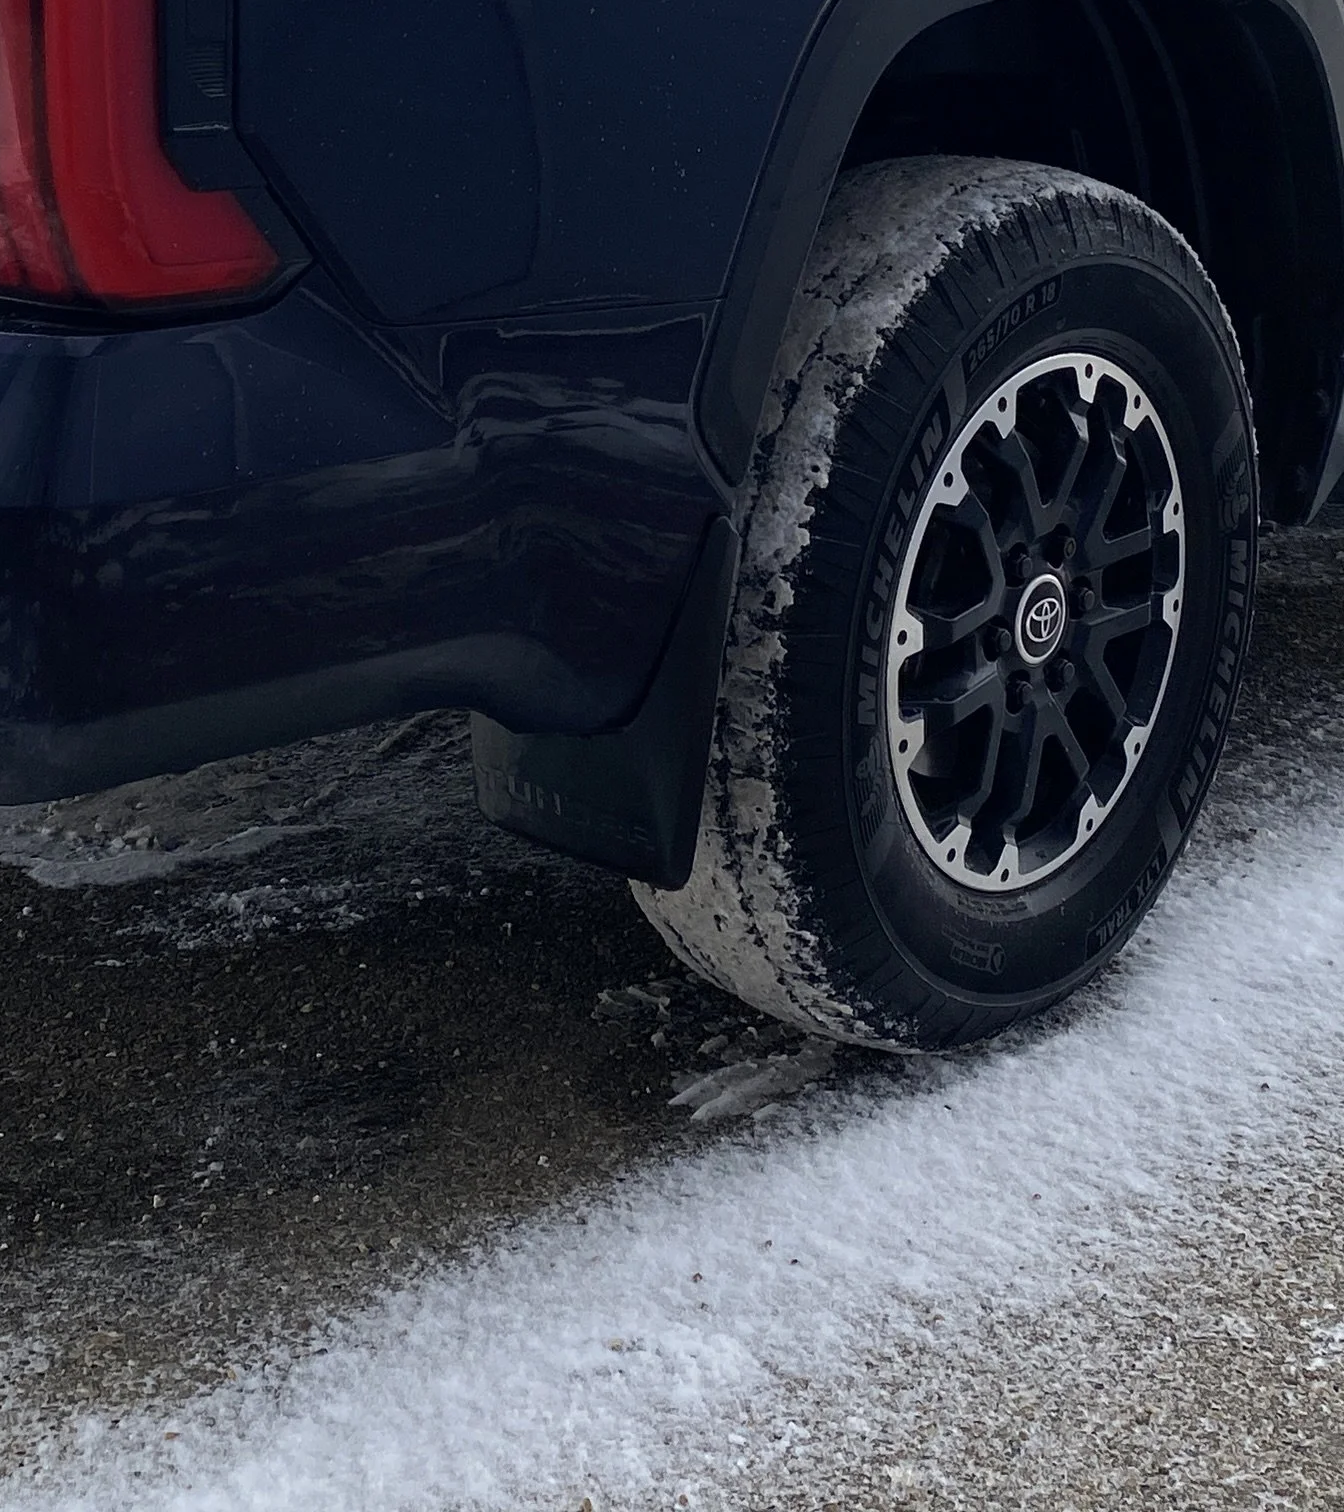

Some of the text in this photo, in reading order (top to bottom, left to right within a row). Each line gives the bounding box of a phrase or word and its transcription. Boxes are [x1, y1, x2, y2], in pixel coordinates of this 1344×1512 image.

[1025, 294, 1037, 317] R
[1040, 281, 1057, 307] 18
[856, 410, 946, 726] MICHELIN
[1176, 538, 1249, 814] MICHELIN
[1096, 858, 1161, 947] LTX TRAIL
